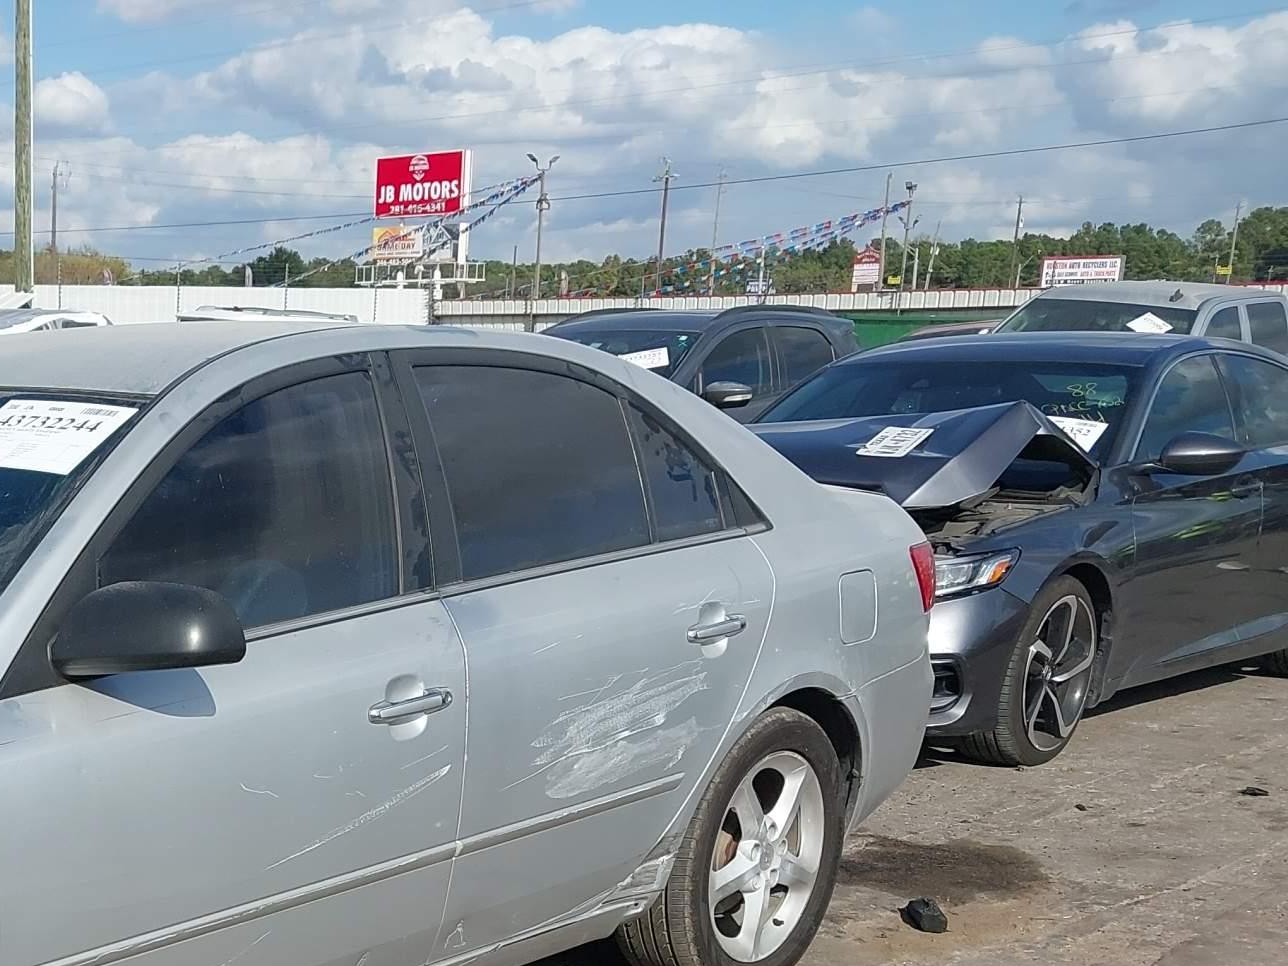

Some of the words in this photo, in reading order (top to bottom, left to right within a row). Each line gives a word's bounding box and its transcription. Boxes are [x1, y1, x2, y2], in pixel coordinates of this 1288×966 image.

[378, 185, 395, 204] JB
[399, 180, 459, 202] MOTORS
[1082, 261, 1108, 269] RECYCLERS
